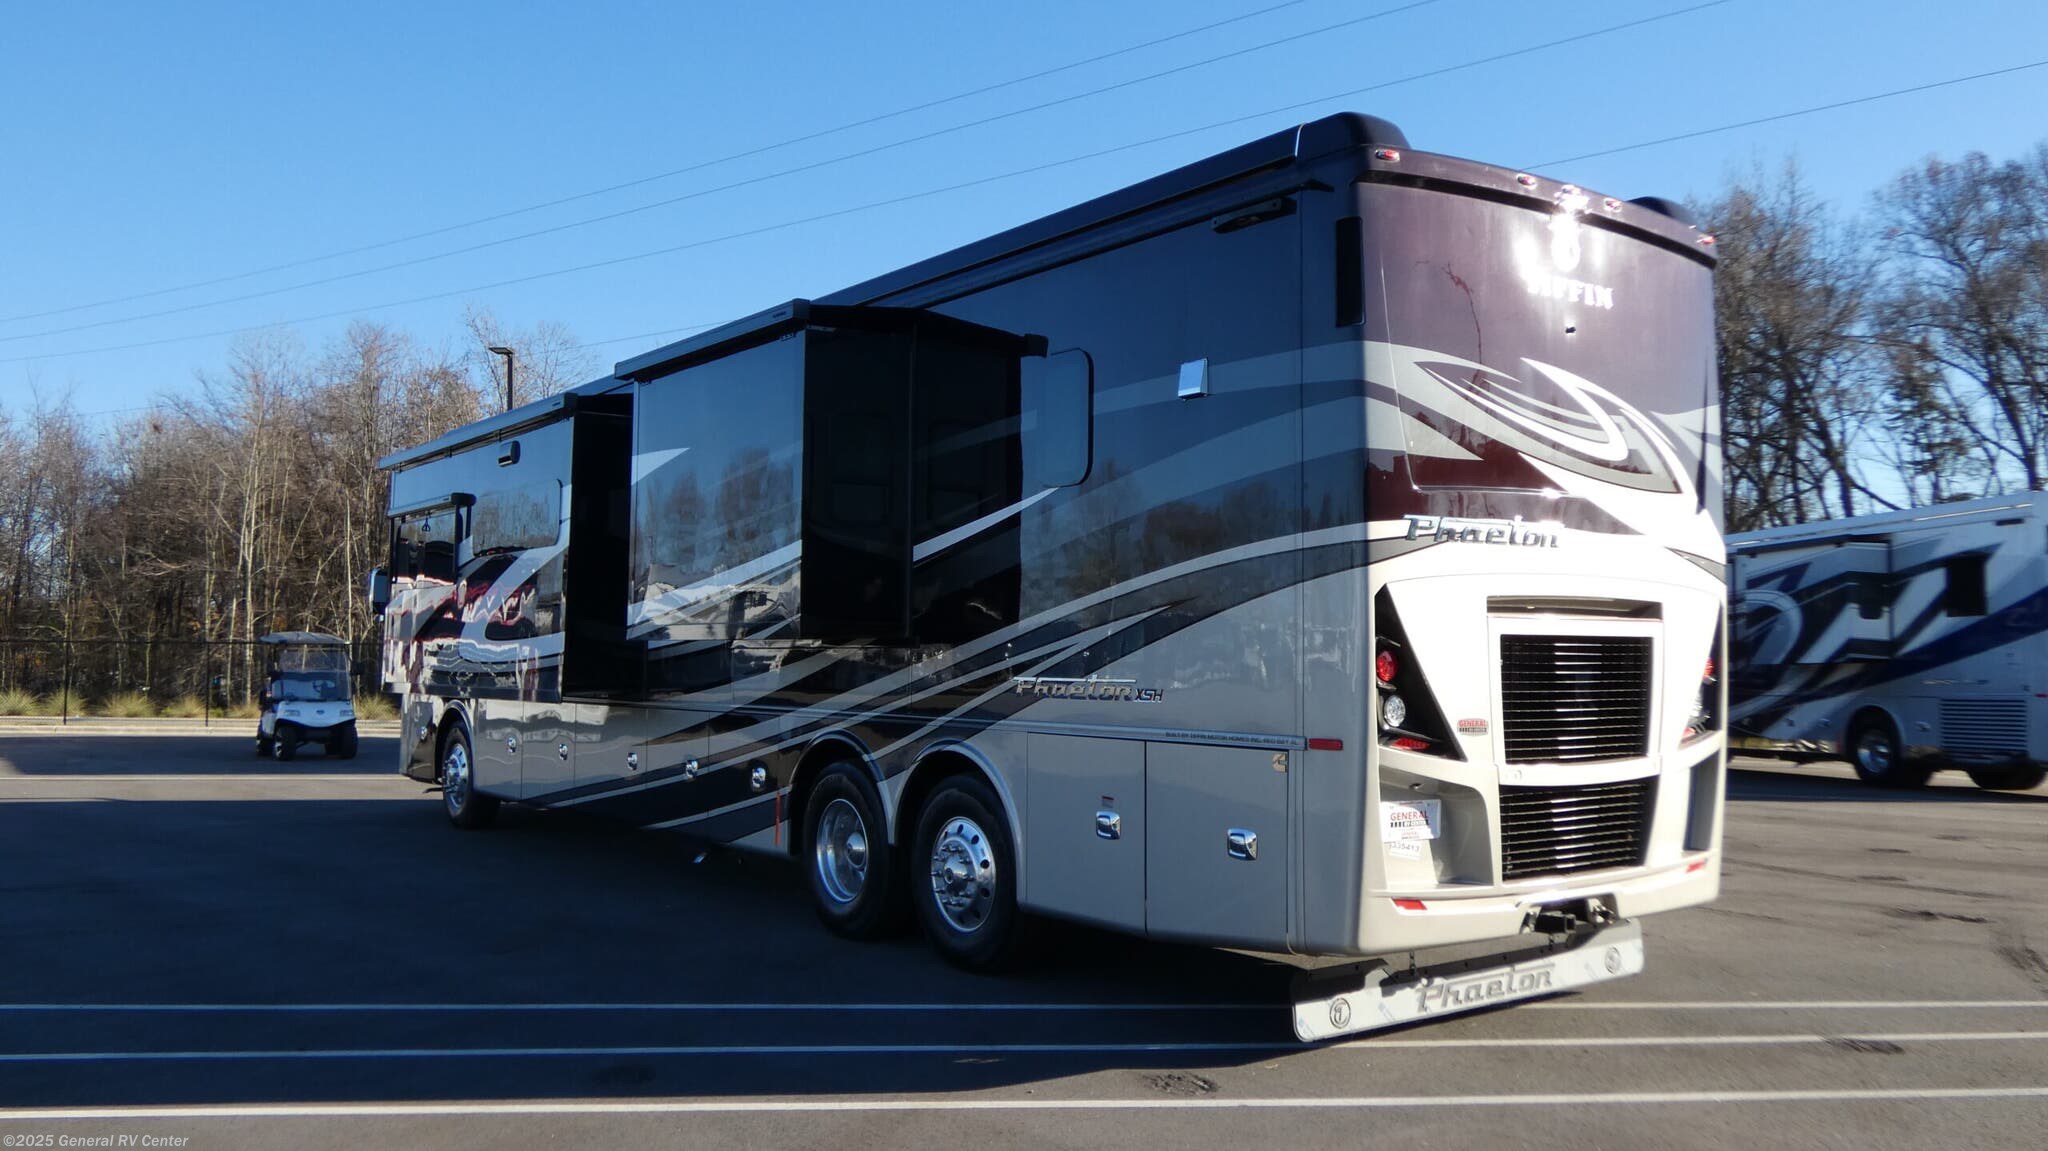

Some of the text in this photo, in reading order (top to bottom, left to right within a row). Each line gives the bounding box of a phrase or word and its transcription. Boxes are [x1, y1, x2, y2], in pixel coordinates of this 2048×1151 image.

[1402, 515, 1565, 548] Phaeton
[1013, 674, 1164, 703] Phaeton XSH
[1390, 810, 1430, 822] GENERAL
[1415, 963, 1556, 1013] Phaeton
